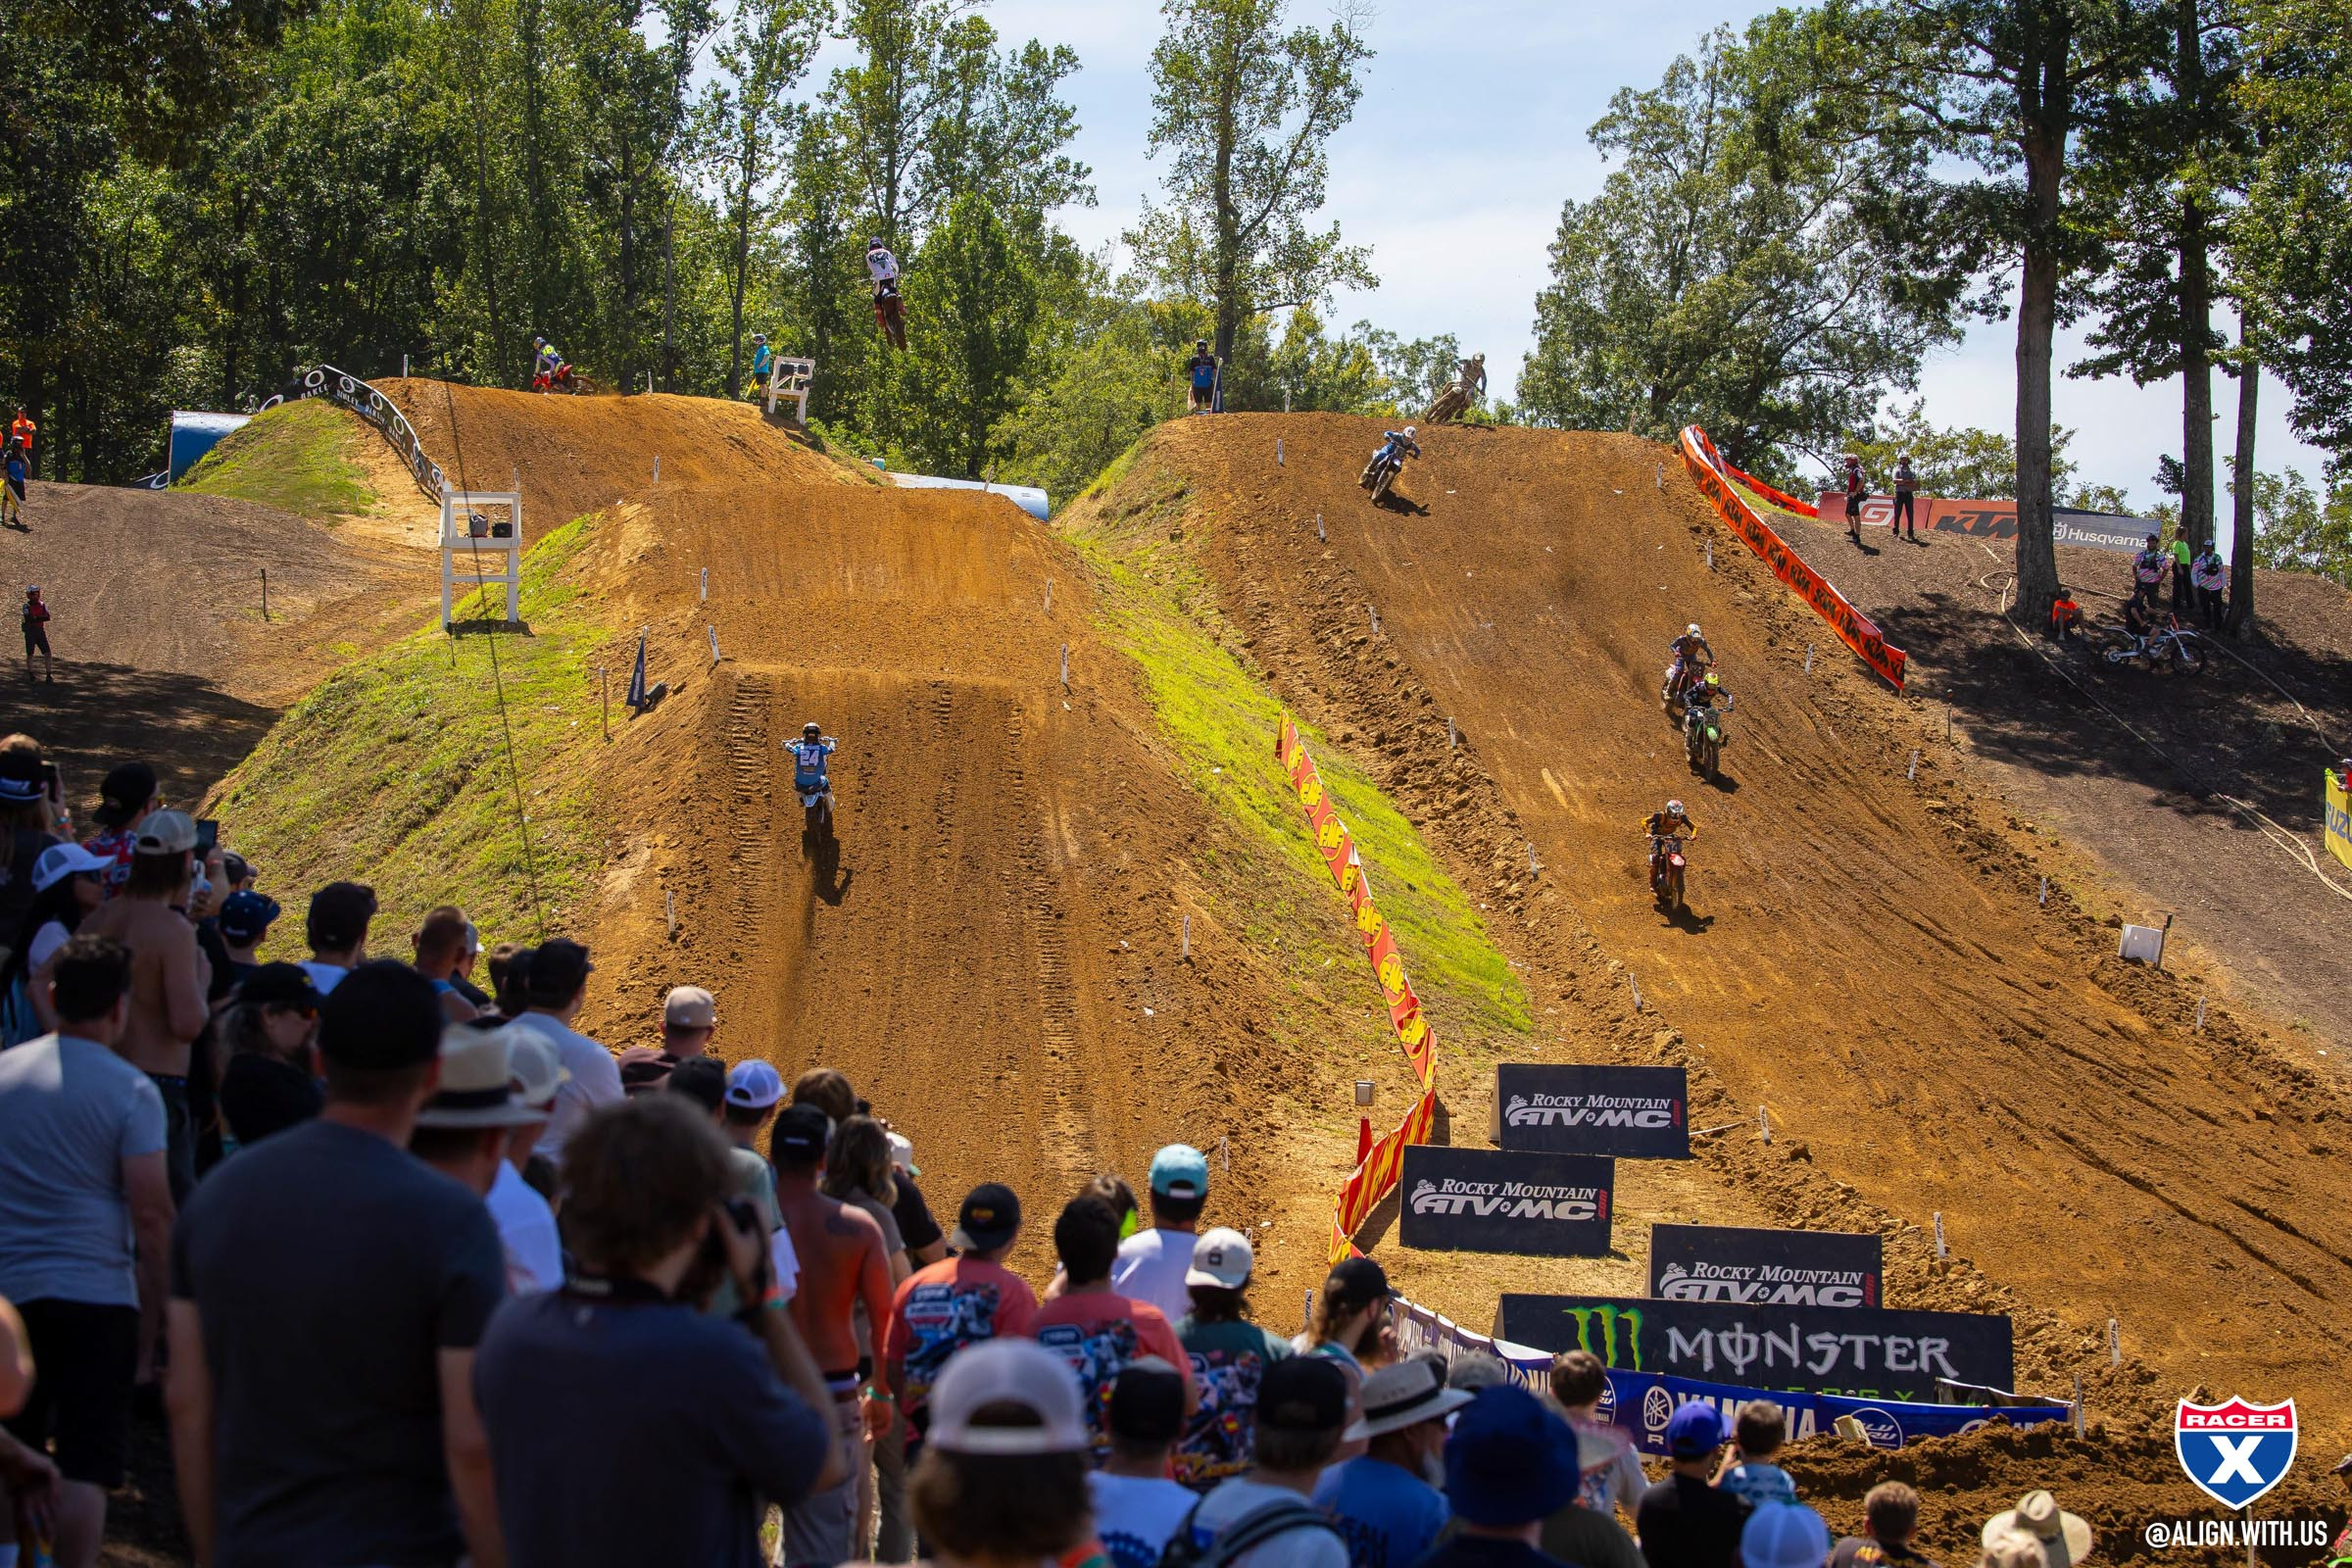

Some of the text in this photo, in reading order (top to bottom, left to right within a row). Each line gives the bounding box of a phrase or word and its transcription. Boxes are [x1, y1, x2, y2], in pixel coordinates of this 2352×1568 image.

[301, 384, 330, 400] OAKLE
[2068, 528, 2148, 548] Husqvarna
[800, 751, 819, 766] 24
[1319, 819, 1345, 849] FMF
[1532, 1093, 1672, 1109] ROCKY MOUNTAIN
[1440, 1178, 1598, 1200] ROCKY MOUNTAIN
[1691, 1262, 1864, 1286] ROCKY MOUNTAIN
[1666, 1322, 1960, 1378] MONSTER
